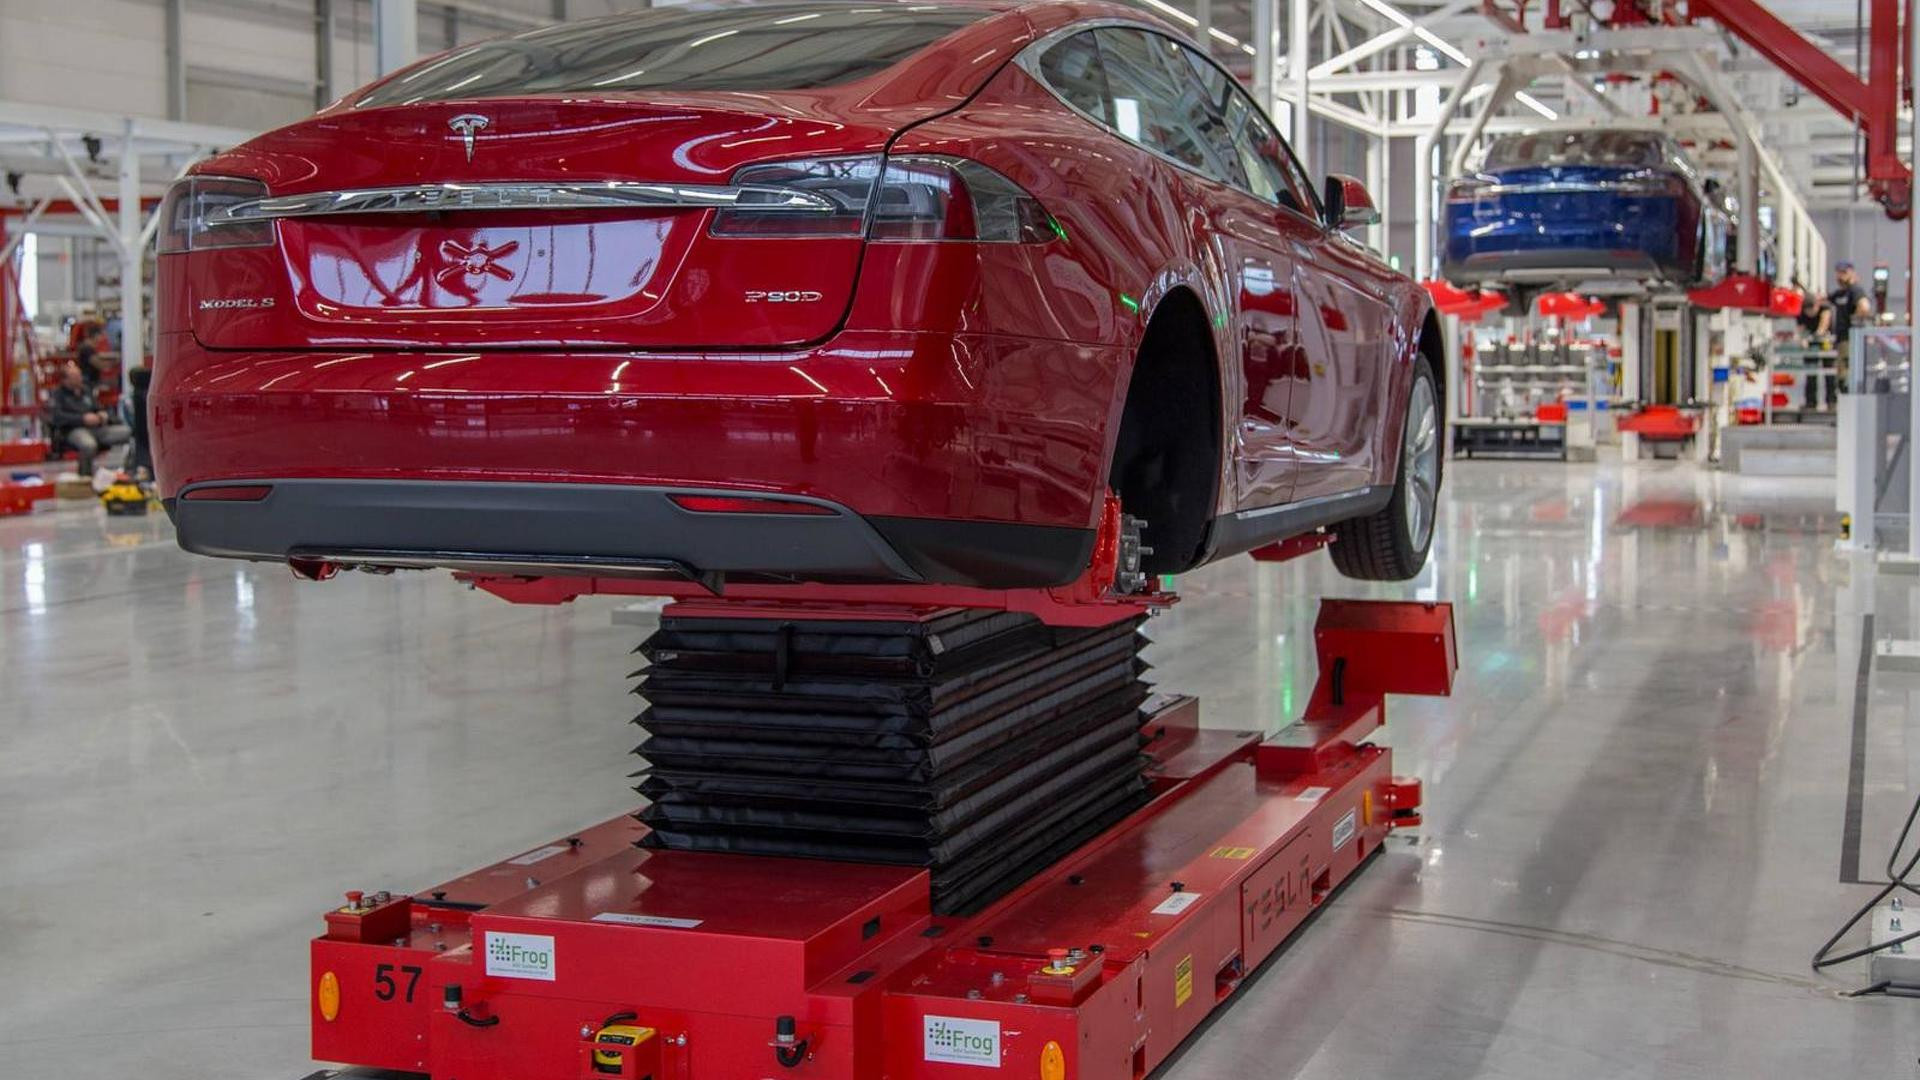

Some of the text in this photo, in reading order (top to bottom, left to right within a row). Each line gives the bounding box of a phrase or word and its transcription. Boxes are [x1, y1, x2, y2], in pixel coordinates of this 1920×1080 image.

[391, 188, 552, 208] TESLA
[199, 297, 276, 310] MODEL S
[744, 290, 823, 303] P90D
[1247, 853, 1311, 943] TESLA
[511, 945, 548, 970] Frog
[375, 963, 423, 1004] 57
[953, 1030, 993, 1056] Frog
